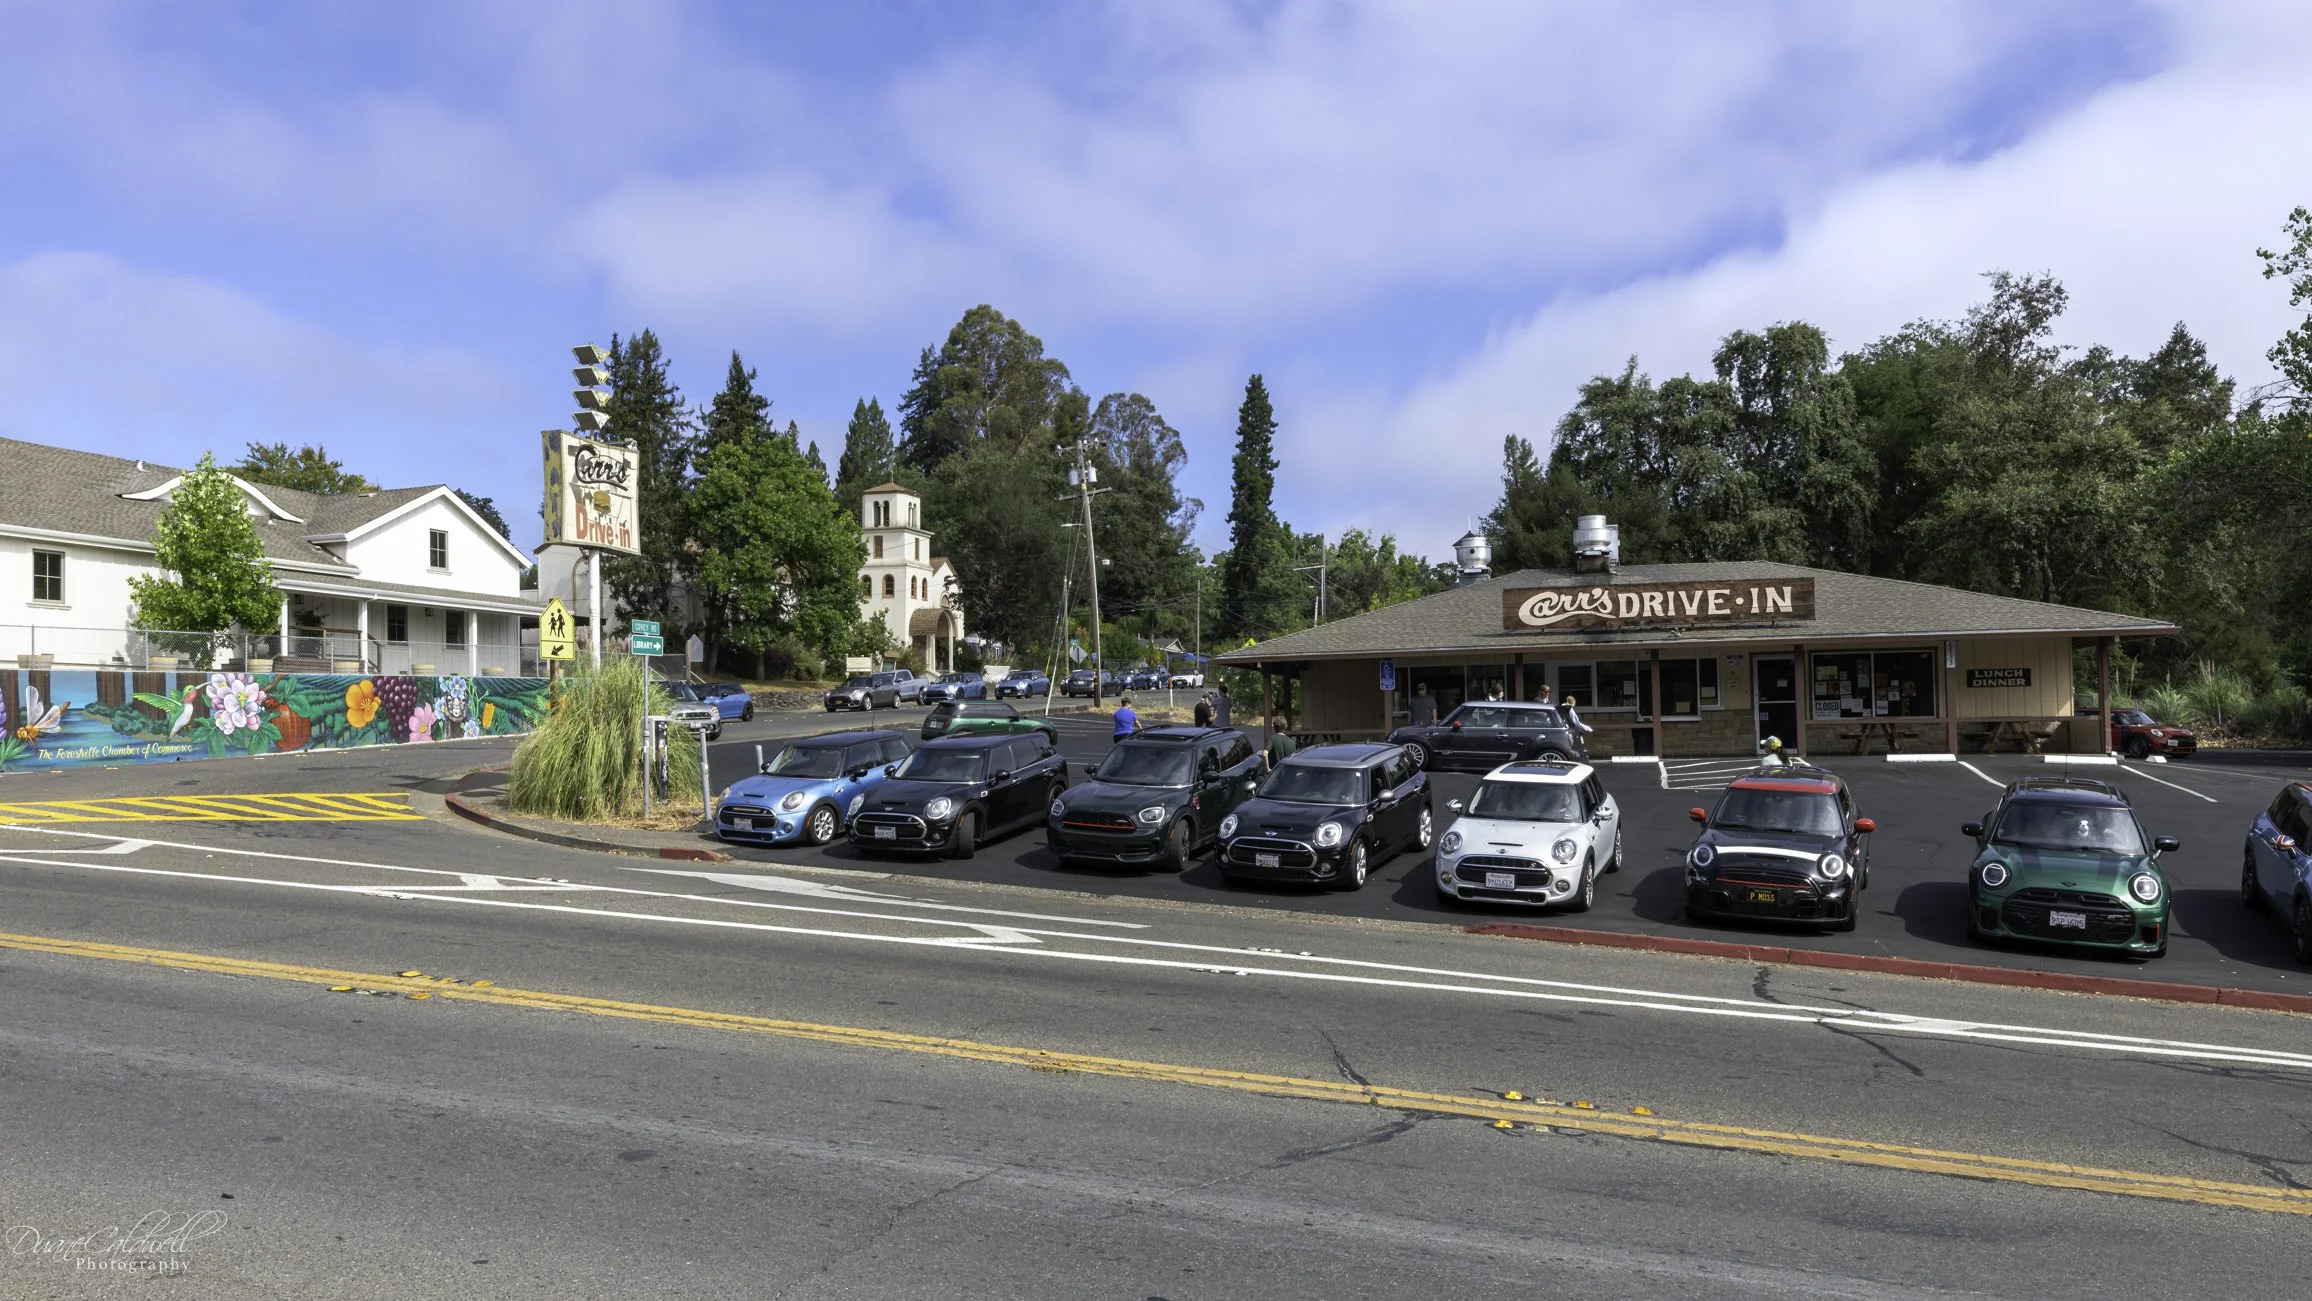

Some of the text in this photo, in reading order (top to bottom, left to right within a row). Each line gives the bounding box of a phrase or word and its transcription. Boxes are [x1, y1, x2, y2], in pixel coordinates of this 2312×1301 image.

[575, 444, 630, 491] Carr's
[1518, 587, 1616, 626] Carr's
[633, 641, 653, 650] LIBRARY
[1975, 669, 2024, 678] LUNCH
[1972, 678, 2027, 687] DINNER
[1815, 701, 1839, 711] CLOSED
[39, 742, 193, 760] The Forestville Chamber of Commerce
[1750, 891, 1755, 900] P
[1758, 893, 1775, 902] MOSS
